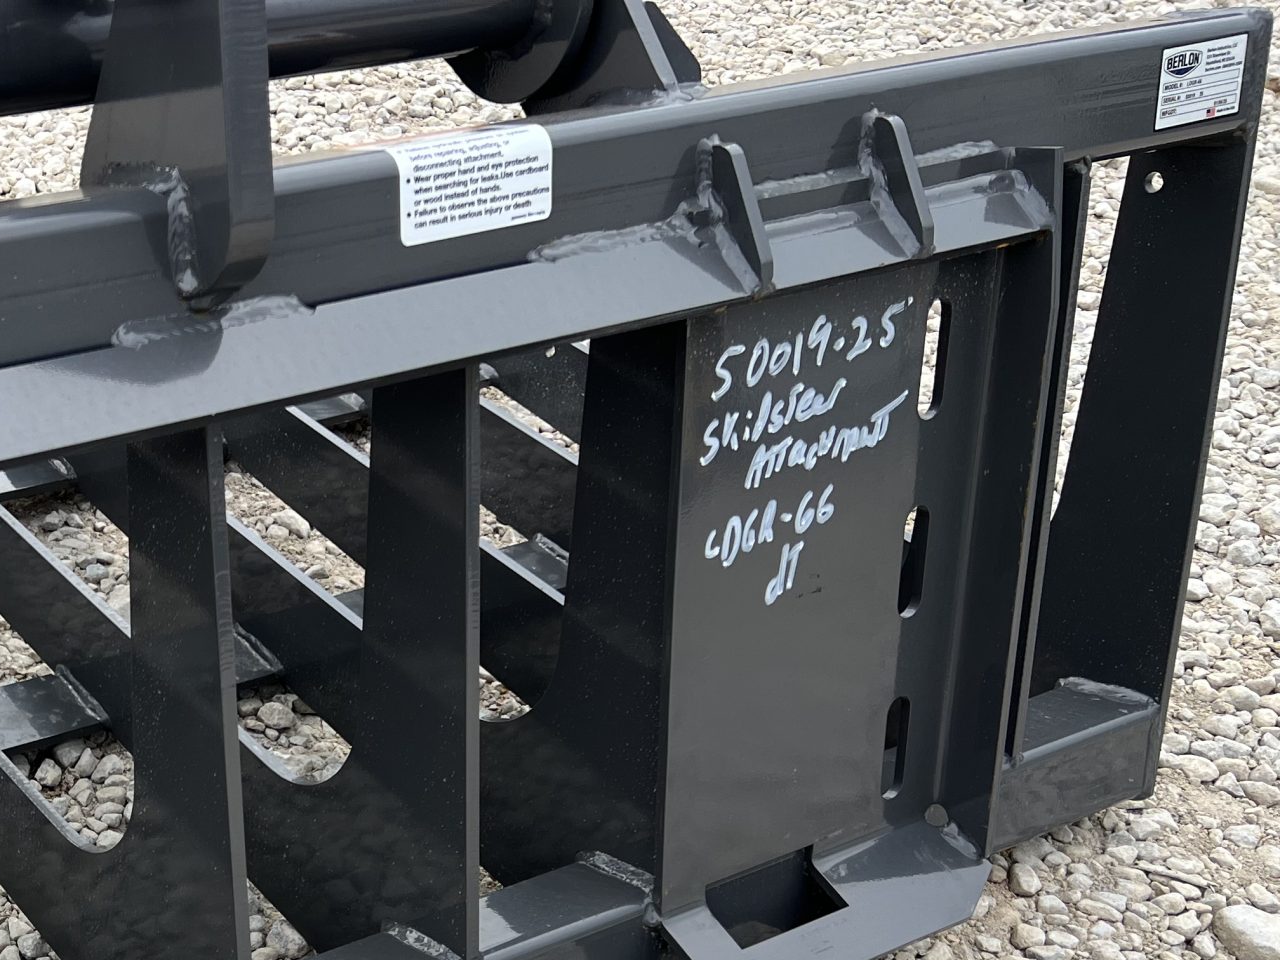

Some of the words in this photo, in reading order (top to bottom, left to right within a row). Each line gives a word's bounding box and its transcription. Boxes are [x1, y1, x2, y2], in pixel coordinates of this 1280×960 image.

[1166, 52, 1200, 70] BERLON
[413, 159, 461, 173] disconnecting
[414, 175, 431, 183] Wear
[433, 170, 456, 182] proper
[458, 166, 475, 176] hand
[477, 163, 490, 172] and
[491, 162, 503, 170] eye
[505, 156, 538, 168] protection
[414, 186, 432, 194] when
[434, 179, 468, 191] searching
[470, 177, 479, 185] for
[515, 163, 549, 176] cardboard
[414, 208, 437, 218] Failure
[440, 205, 446, 213] to
[448, 201, 475, 211] observe
[490, 193, 509, 203] above
[511, 186, 549, 200] precautions
[424, 194, 442, 204] wood
[444, 190, 469, 201] instead
[471, 188, 478, 196] of
[480, 184, 501, 194] hands.
[414, 221, 427, 229] can
[429, 216, 448, 226] result
[458, 209, 482, 220] serious
[484, 205, 503, 215] injury
[513, 200, 532, 209] death
